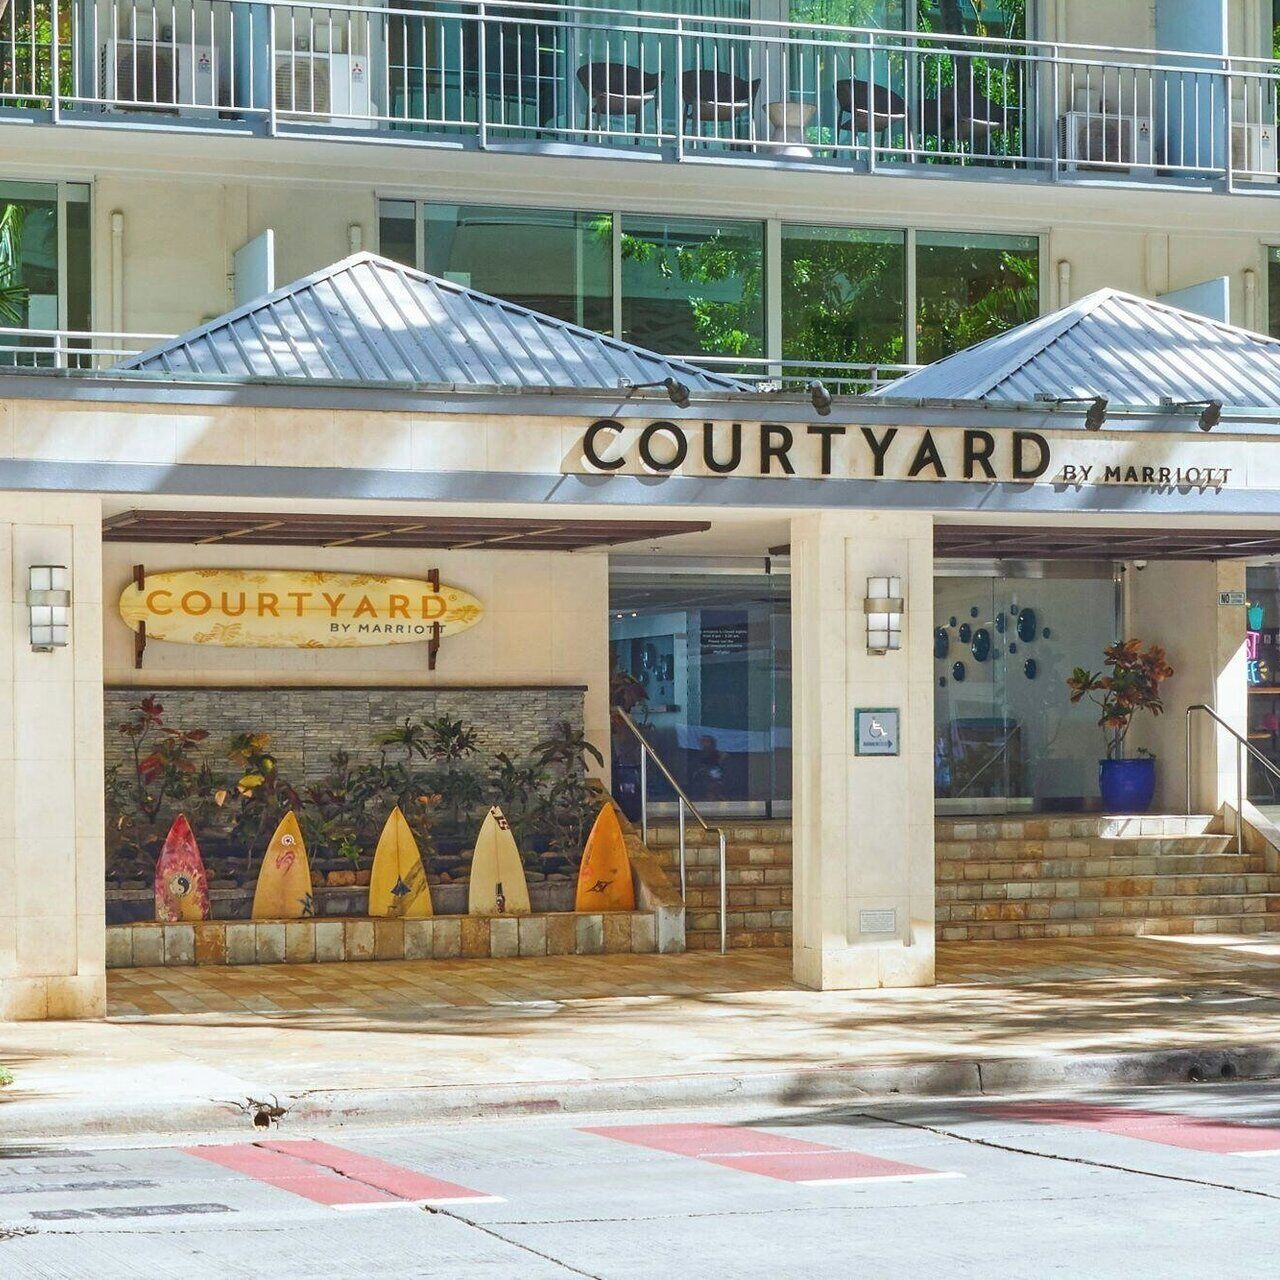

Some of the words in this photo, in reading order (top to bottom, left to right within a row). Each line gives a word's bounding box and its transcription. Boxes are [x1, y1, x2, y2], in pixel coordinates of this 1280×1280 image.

[582, 419, 1051, 479] COURTYARD
[1062, 465, 1093, 481] BY
[1104, 465, 1233, 484] MARRIOTT
[145, 589, 448, 620] COURTYARD
[329, 622, 351, 633] BY
[358, 623, 447, 635] MARRIOTT
